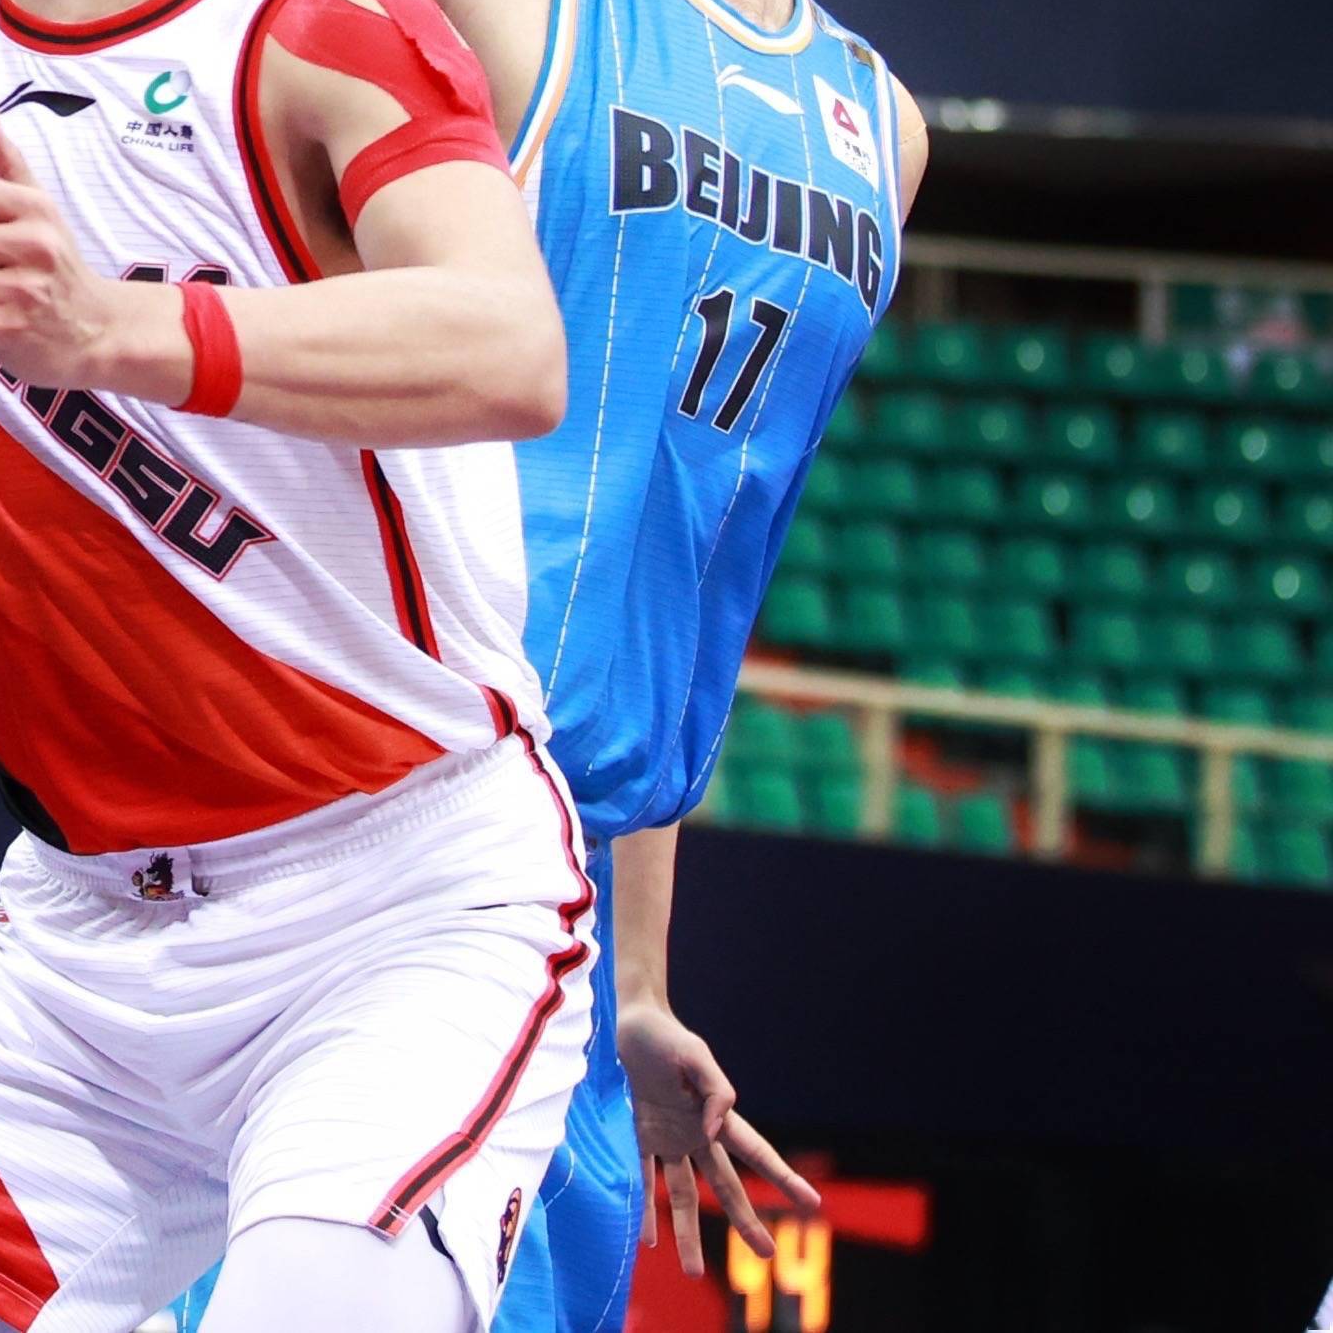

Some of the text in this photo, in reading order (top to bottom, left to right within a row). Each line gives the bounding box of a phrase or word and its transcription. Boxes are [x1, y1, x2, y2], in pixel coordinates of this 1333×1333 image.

[121, 135, 195, 153] CHINA LIFE
[609, 105, 884, 327] BEIJING
[677, 285, 791, 434] 17
